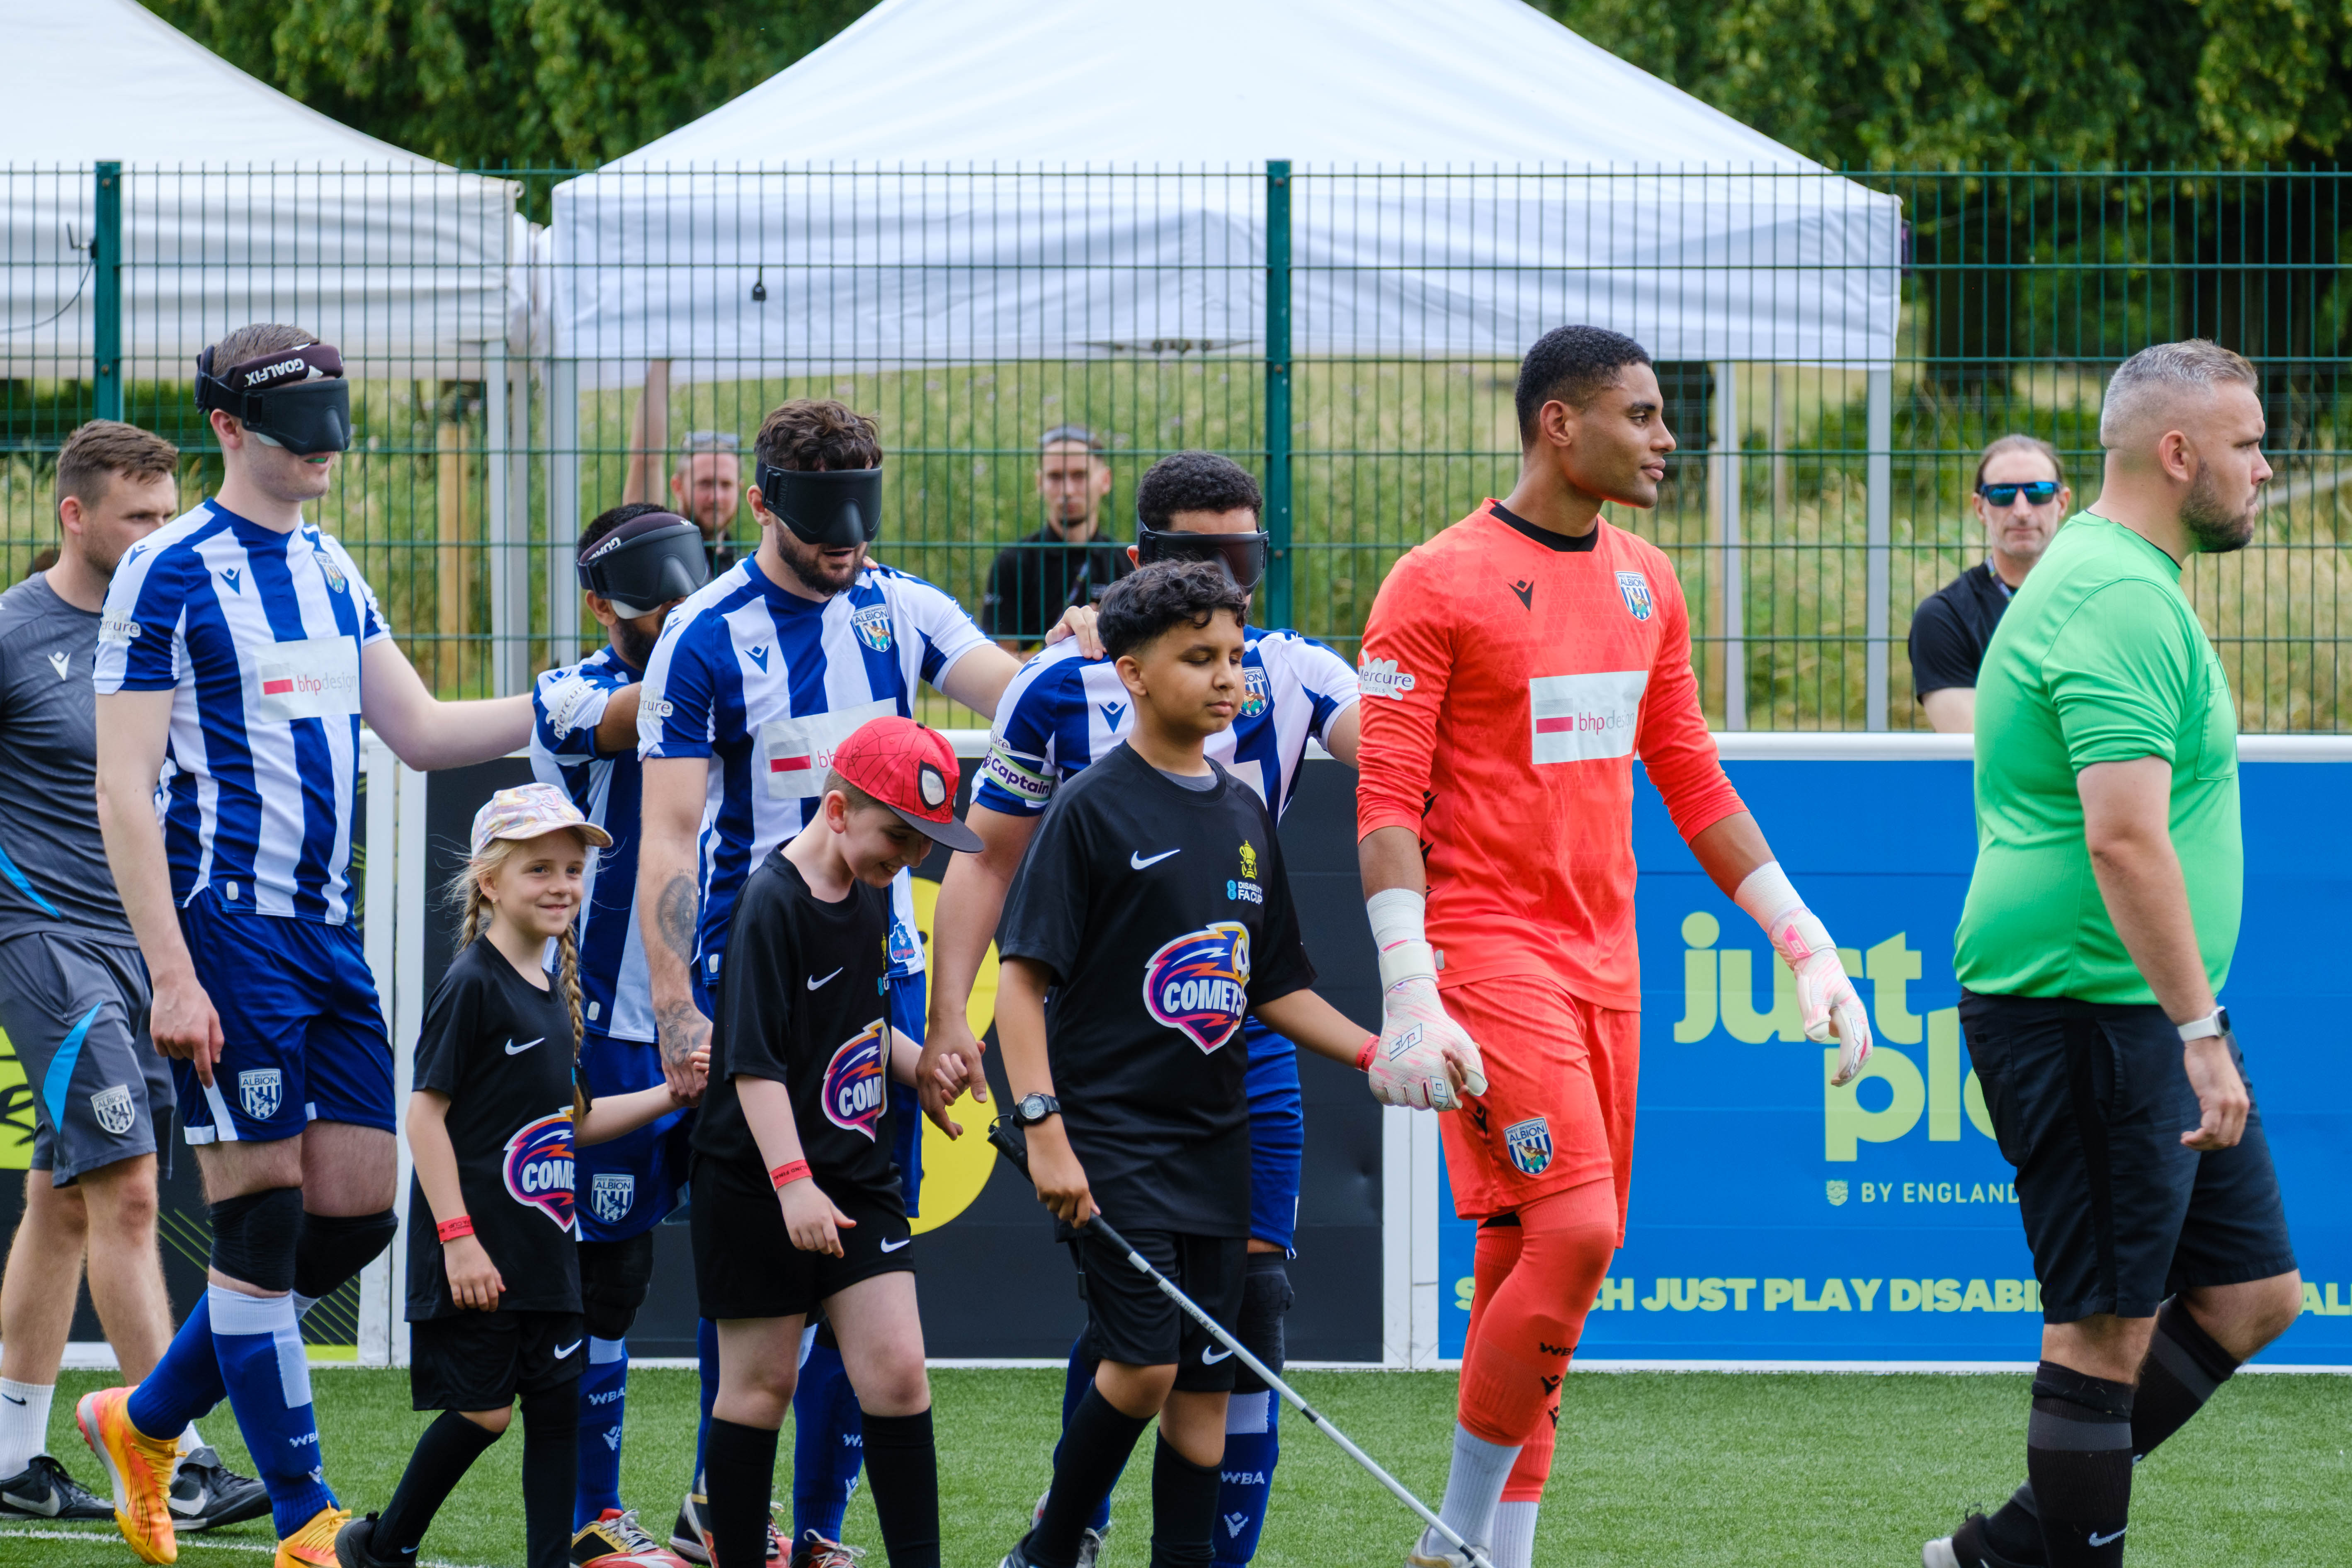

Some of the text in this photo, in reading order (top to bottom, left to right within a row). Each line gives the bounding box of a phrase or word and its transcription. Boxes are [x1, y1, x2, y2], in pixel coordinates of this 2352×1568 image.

[245, 358, 305, 386] GOALFIX
[1620, 578, 1645, 587] ALBION
[855, 611, 888, 624] ALBION
[296, 671, 357, 696] bhpdesign
[1244, 673, 1263, 683] ION
[1359, 669, 1412, 687] Mercure
[1579, 709, 1635, 736] bhpdesign
[990, 730, 1009, 749] cure
[991, 758, 1049, 795] Captain
[1238, 881, 1262, 895] DISABILITY
[1238, 889, 1262, 905] FA CUP
[1673, 911, 1922, 1044] jut
[1163, 980, 1244, 1017] COMETS
[242, 1076, 277, 1086] ALBION
[1824, 1006, 1998, 1162] pl
[839, 1076, 881, 1117] COM
[1510, 1124, 1546, 1143] ALBION
[522, 1160, 575, 1193] COME
[595, 1181, 630, 1189] ALBION
[1861, 1182, 2019, 1204] BY ENGLAND
[1641, 1277, 1757, 1311] JUST
[1763, 1279, 1883, 1311] PLAY
[1889, 1279, 2044, 1312] DISABI
[589, 1387, 625, 1405] WBA
[1221, 1471, 1265, 1485] WBA
